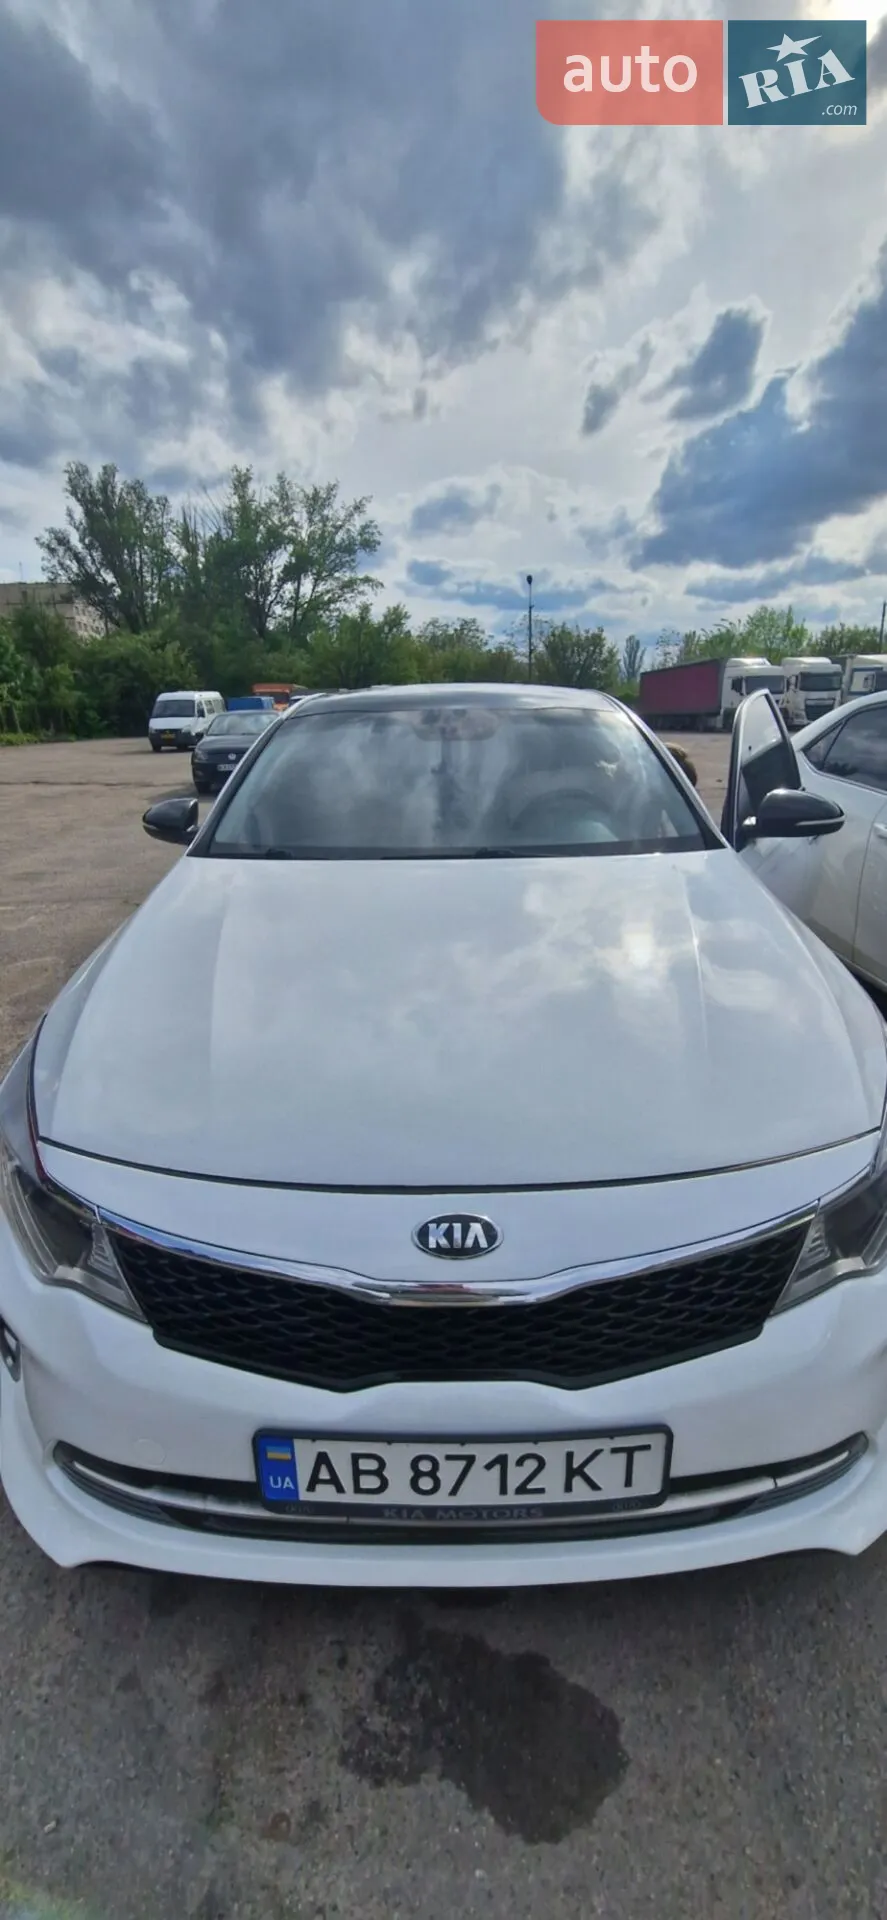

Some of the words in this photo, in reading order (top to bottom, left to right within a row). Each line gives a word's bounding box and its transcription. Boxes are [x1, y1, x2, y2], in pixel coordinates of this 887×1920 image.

[427, 1222, 489, 1249] KIA
[306, 1451, 390, 1495] AB
[410, 1453, 547, 1496] 8712
[563, 1443, 652, 1493] KT
[269, 1475, 296, 1490] UA
[383, 1508, 426, 1519] KIA
[436, 1507, 544, 1520] MOTORS
